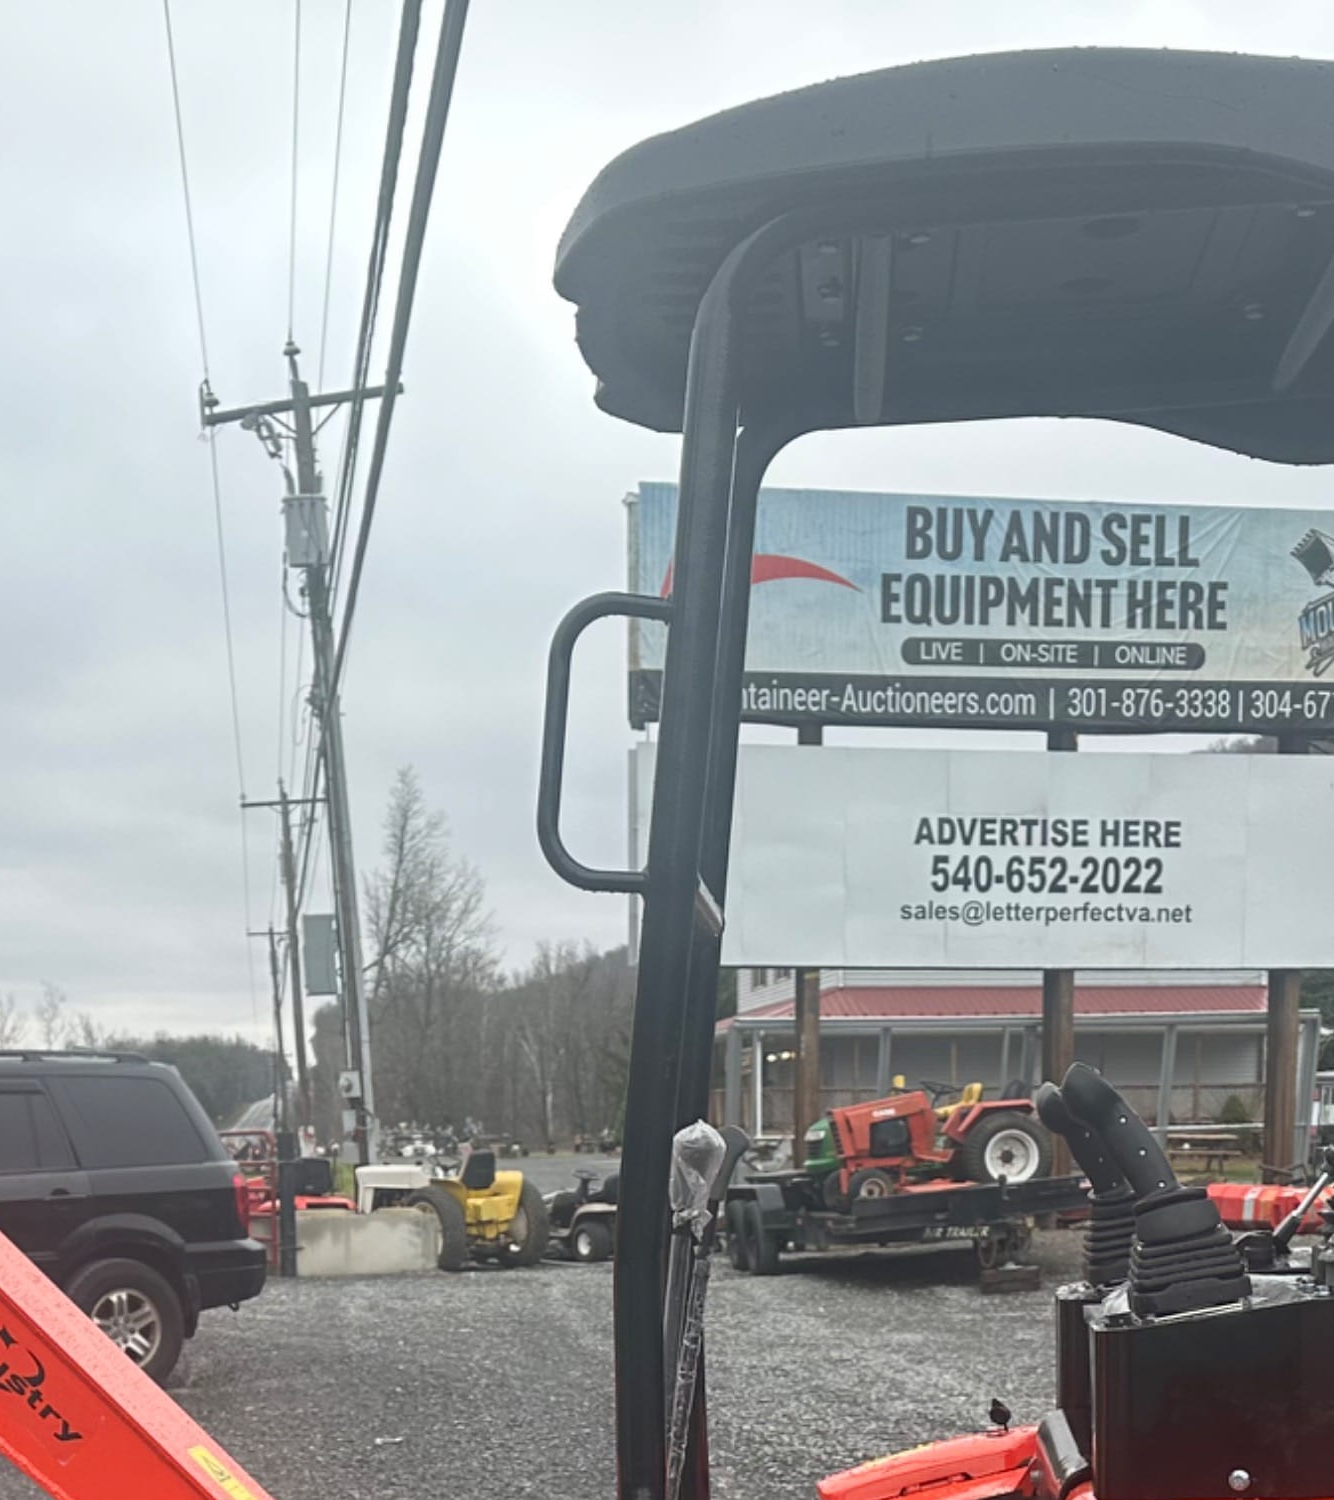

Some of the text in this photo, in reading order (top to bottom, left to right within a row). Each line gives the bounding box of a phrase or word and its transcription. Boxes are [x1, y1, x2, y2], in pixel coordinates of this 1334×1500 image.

[906, 505, 1200, 568] BUY AND SELL
[881, 573, 1228, 630] EQUIPMENT HERE
[920, 642, 1187, 666] LIVE ON-SITE ONLINE
[1068, 687, 1231, 718] 301-876-3338
[914, 817, 1182, 848] ADVERTISE HERE
[931, 855, 1164, 894] 540-652-2022
[900, 900, 1193, 926] sales@letterperfectva.net
